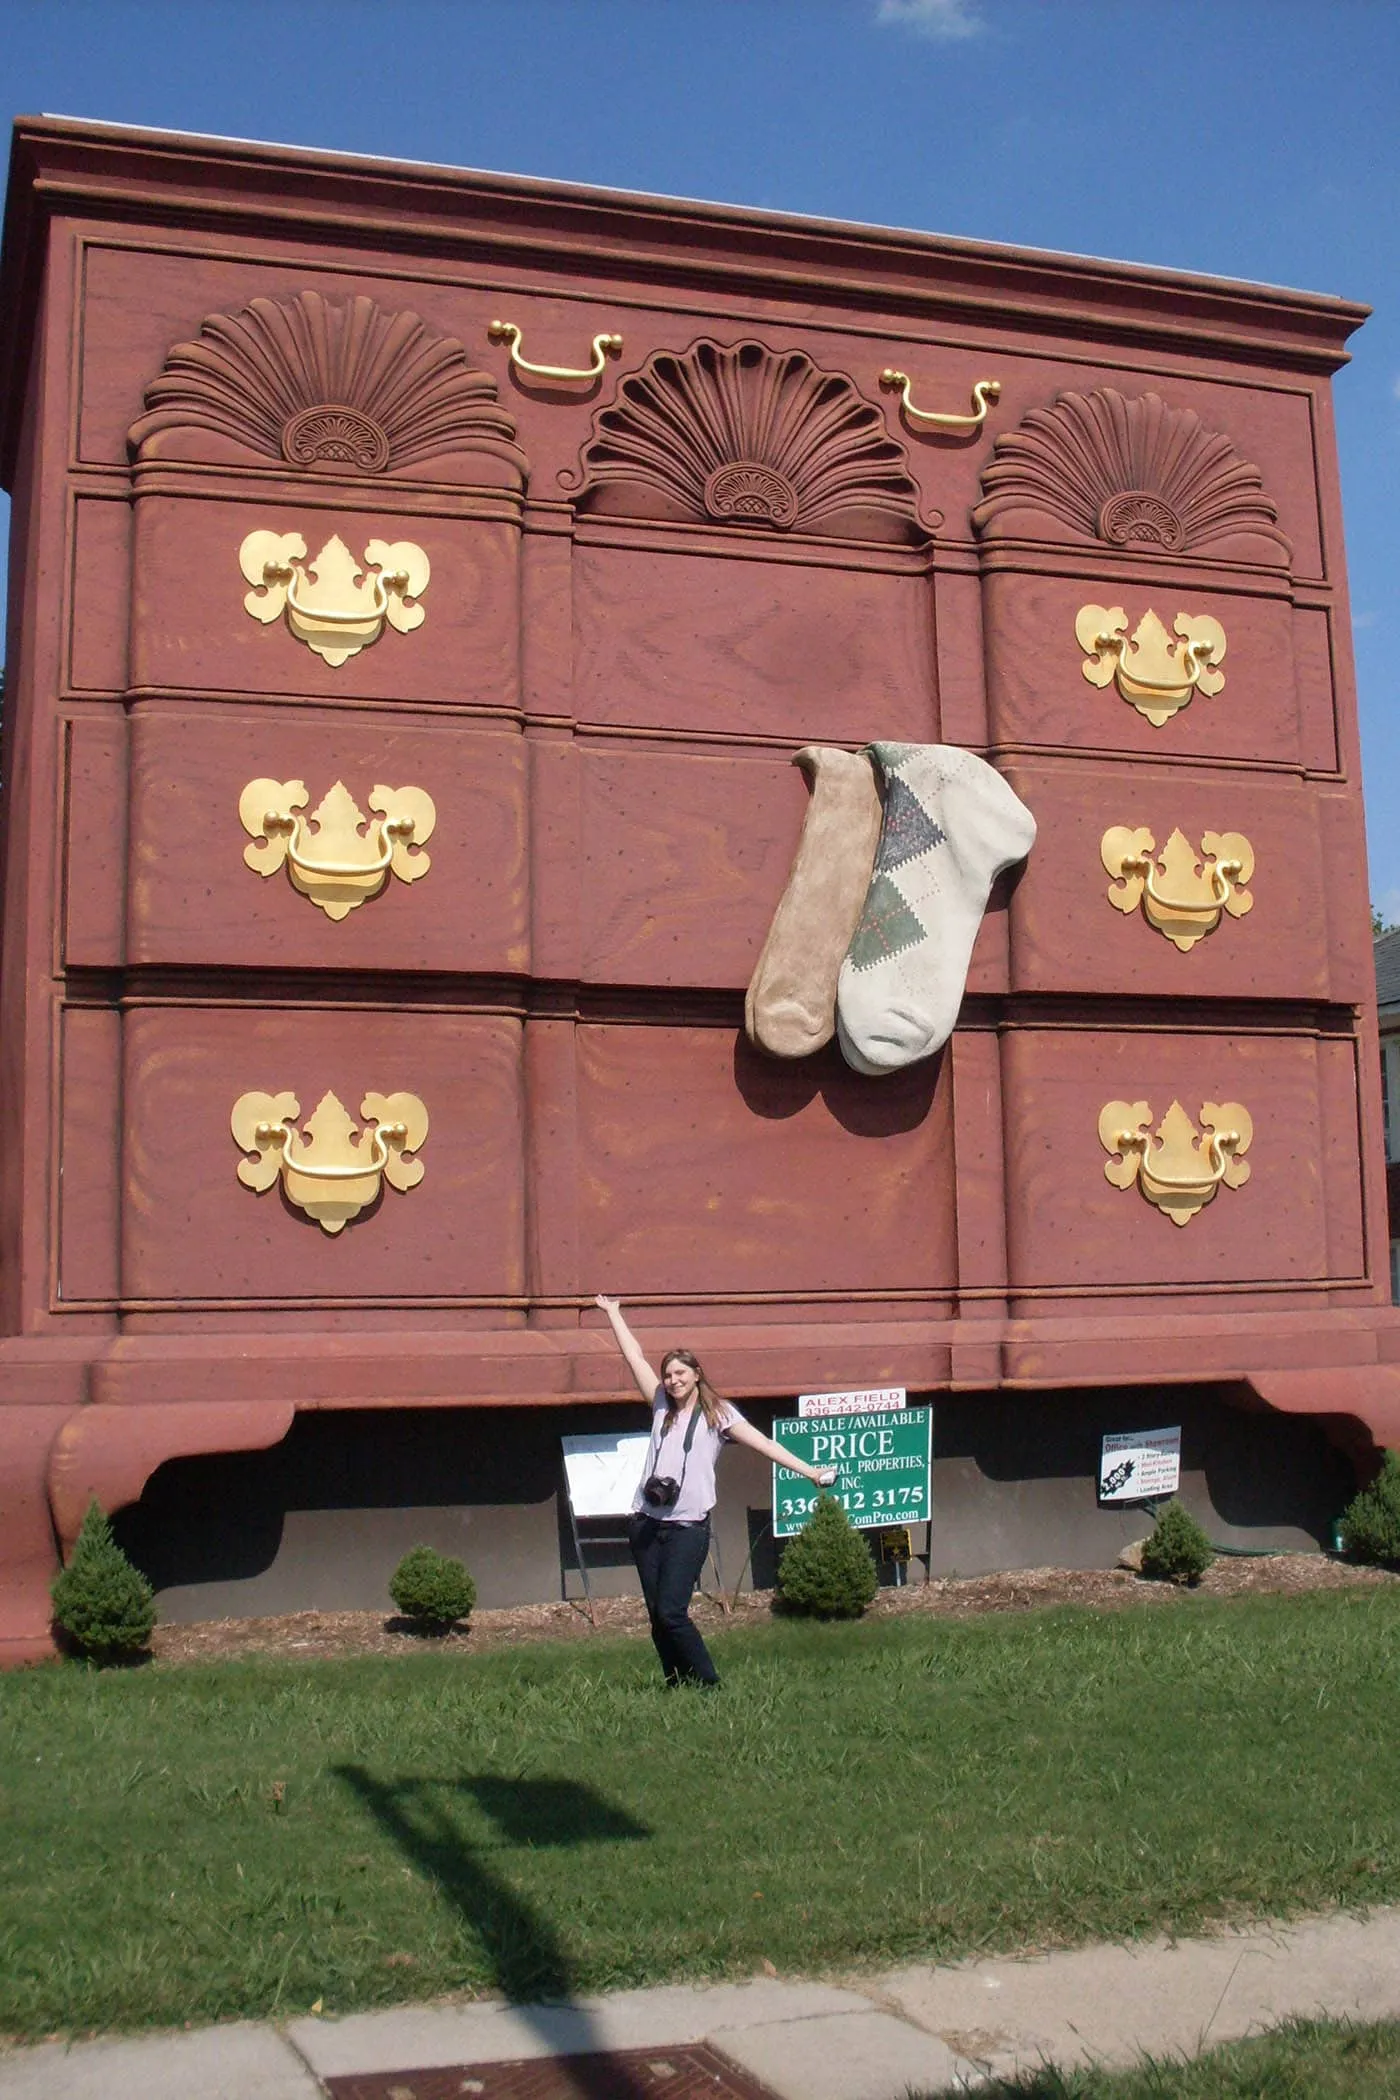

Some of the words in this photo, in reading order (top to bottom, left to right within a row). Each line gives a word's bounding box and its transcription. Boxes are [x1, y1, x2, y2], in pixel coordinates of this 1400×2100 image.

[806, 1397, 848, 1407] ALEX
[854, 1392, 900, 1404] FIELD
[781, 1421, 808, 1435] FOR
[811, 1418, 846, 1432] SALE
[811, 1430, 895, 1461] PRICE
[841, 1476, 864, 1490] INC.
[833, 1492, 865, 1510] 12
[872, 1486, 923, 1507] 3175
